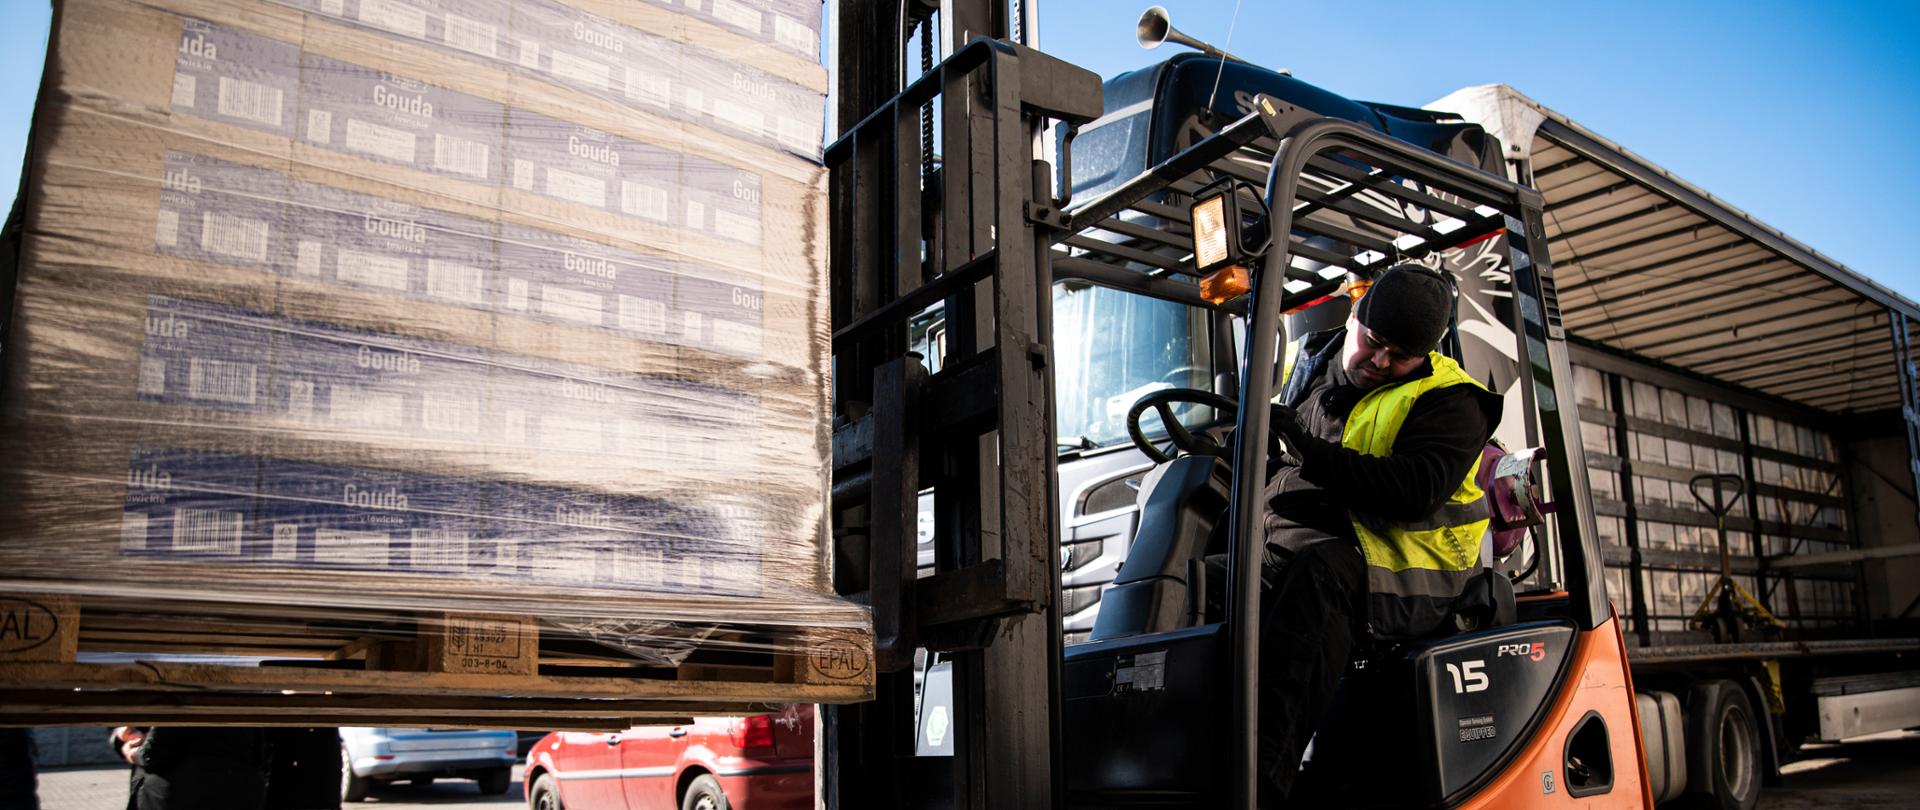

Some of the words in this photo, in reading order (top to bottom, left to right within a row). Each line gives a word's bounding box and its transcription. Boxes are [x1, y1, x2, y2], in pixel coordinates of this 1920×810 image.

[574, 22, 623, 53] Gouda
[734, 72, 776, 100] Gouda
[373, 84, 433, 118] Gouda
[568, 135, 620, 167] Gouda
[733, 180, 760, 204] Gou
[365, 211, 426, 243] Gouda
[564, 252, 616, 279] Gouda
[145, 312, 188, 339] uda
[358, 345, 420, 375] Gouda
[127, 463, 172, 490] uda
[344, 484, 408, 512] Gouda
[0, 610, 41, 640] AL
[820, 648, 861, 671] EPAL
[1446, 659, 1489, 694] 15
[1459, 726, 1496, 742] EQUIPPED
